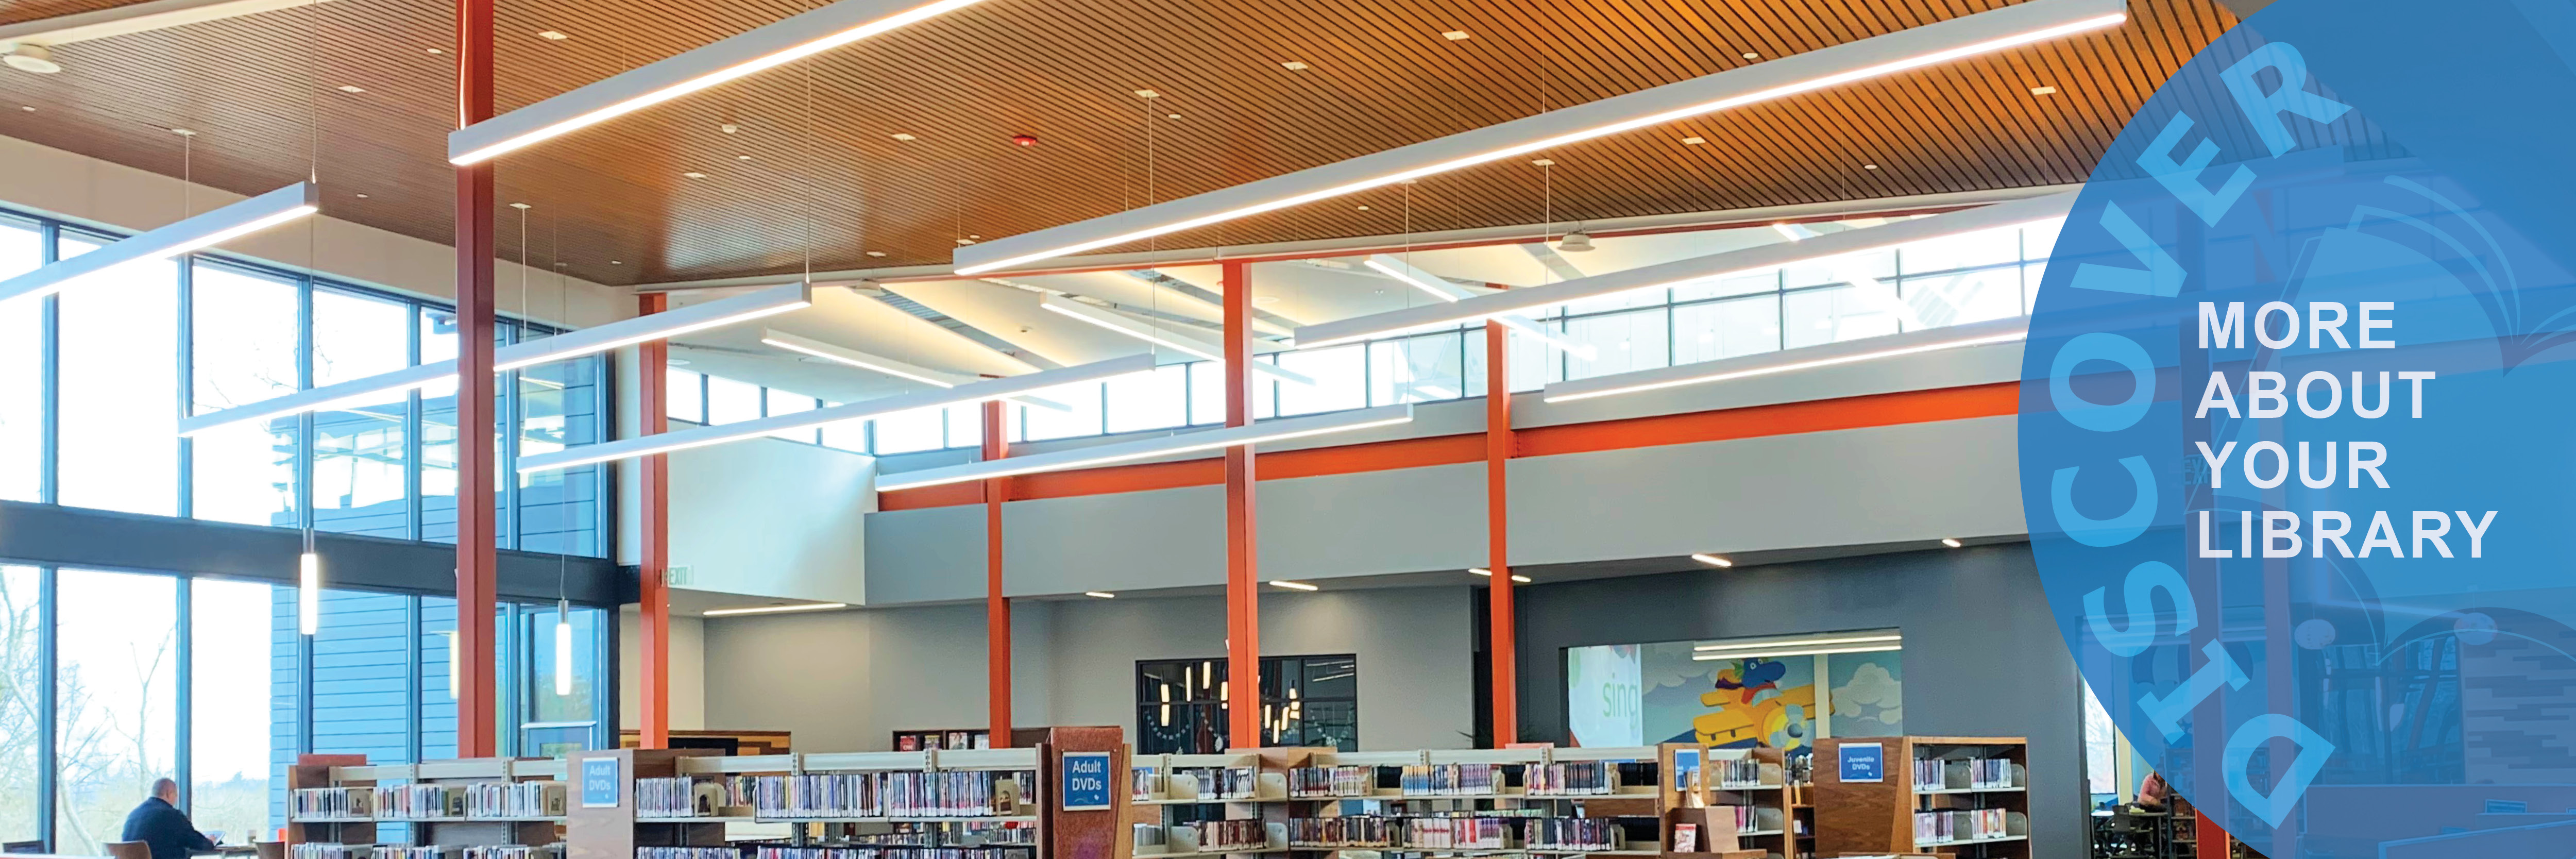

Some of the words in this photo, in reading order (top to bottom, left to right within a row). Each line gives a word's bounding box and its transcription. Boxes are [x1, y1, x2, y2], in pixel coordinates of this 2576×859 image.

[669, 567, 687, 585] EXIT
[1602, 672, 1638, 730] sing
[589, 765, 611, 776] Adult
[1072, 760, 1101, 773] Adult
[589, 780, 611, 791] DVDs
[1072, 778, 1101, 791] DVDs
